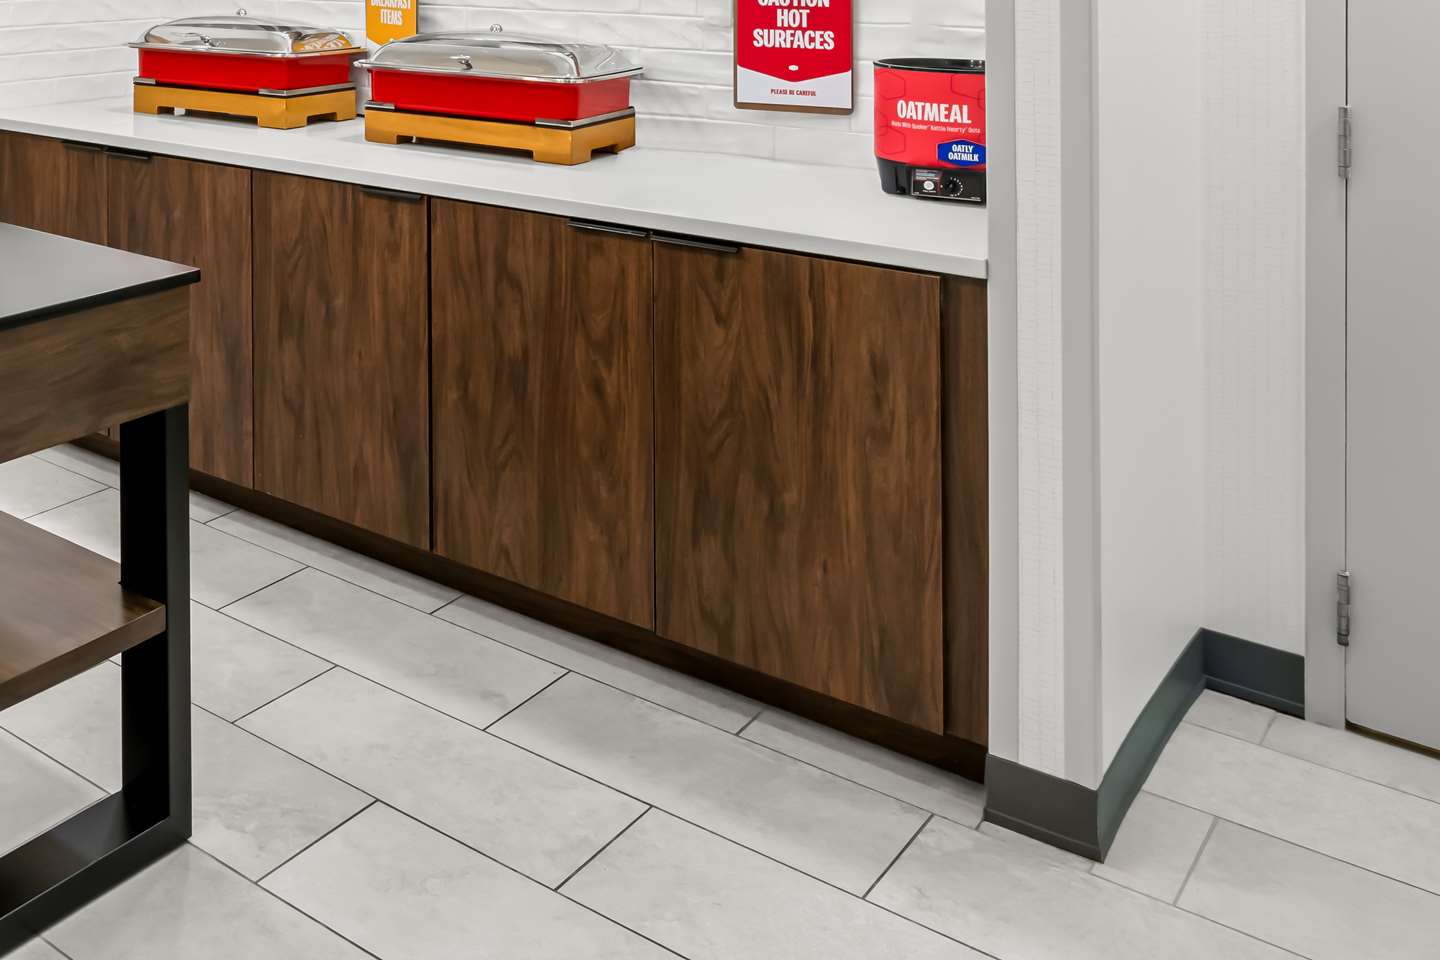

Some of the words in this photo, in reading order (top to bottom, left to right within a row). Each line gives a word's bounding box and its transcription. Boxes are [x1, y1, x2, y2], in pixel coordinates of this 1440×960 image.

[380, 9, 403, 26] ITEMS
[776, 8, 810, 28] HOT
[752, 28, 835, 50] SURFACES
[896, 100, 972, 124] OATMEAL
[947, 152, 980, 162] OATMILK
[951, 144, 974, 153] OATLY
